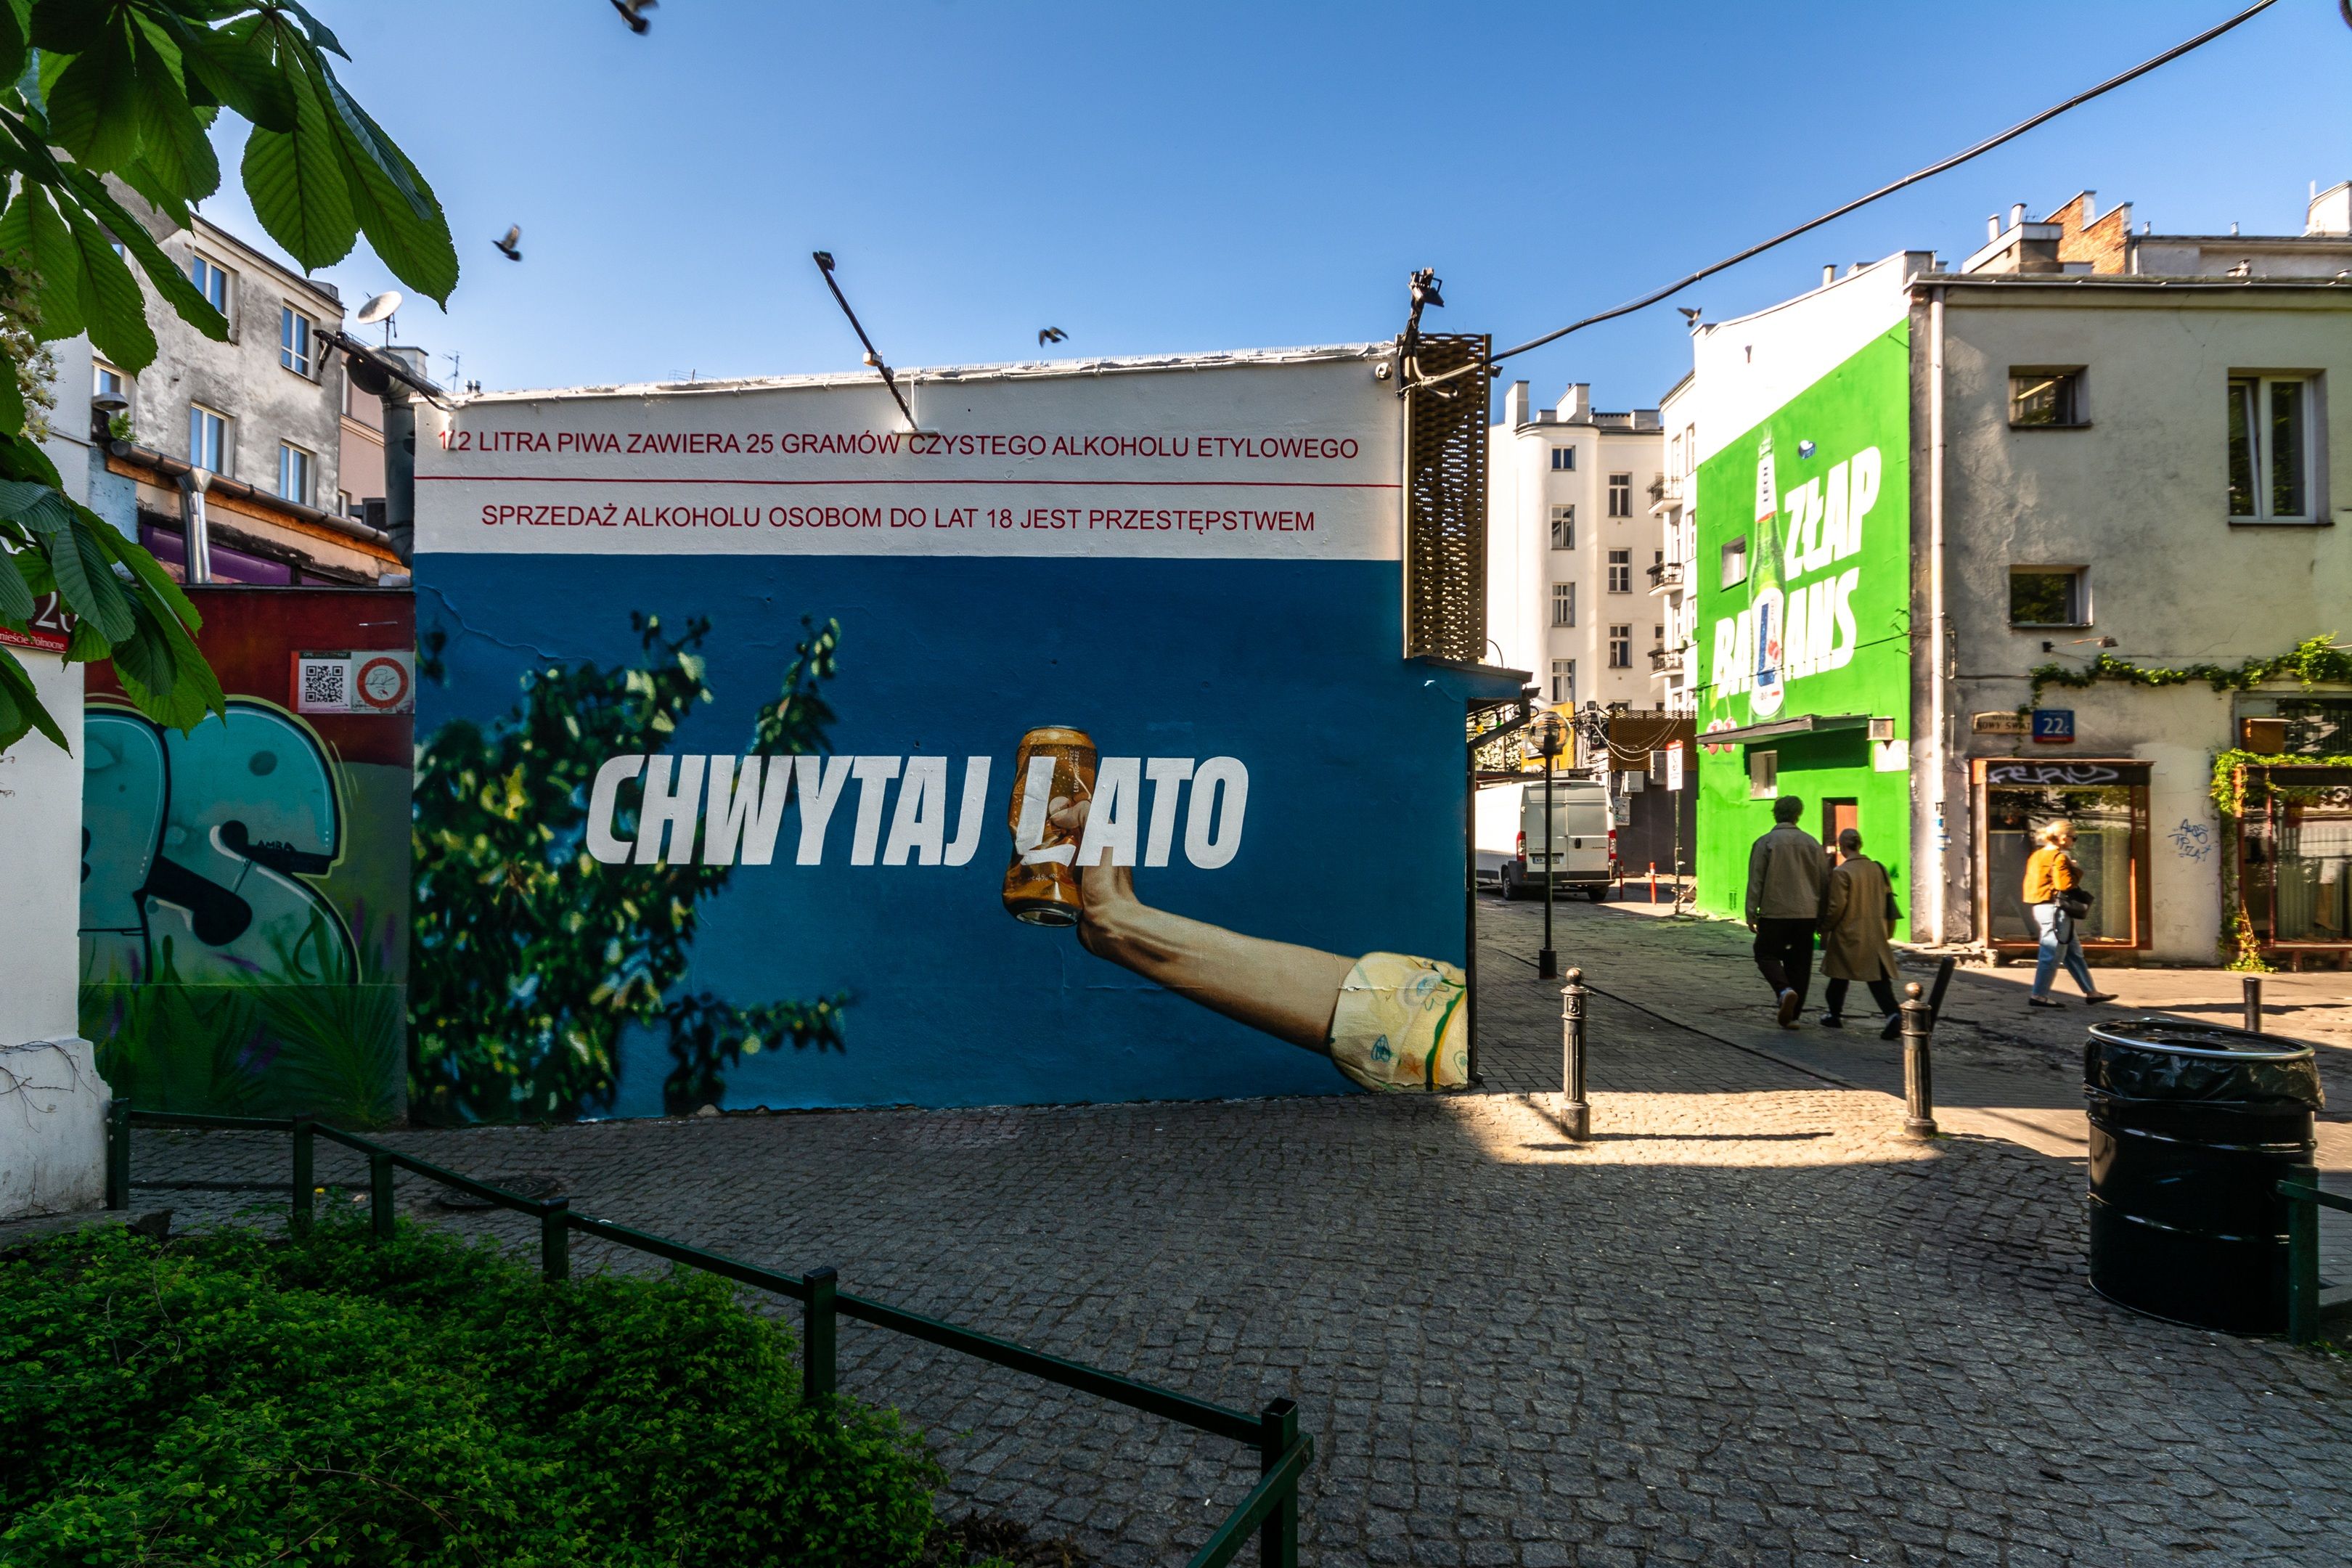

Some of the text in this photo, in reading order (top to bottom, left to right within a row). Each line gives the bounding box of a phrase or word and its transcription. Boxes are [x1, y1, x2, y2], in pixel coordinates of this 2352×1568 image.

[438, 430, 1359, 459] 1/2 LITRA PIWA ZAWIERA 25 GRAMÓW CZYSTEGO ALKOHOLU ETYLOWEGO
[482, 502, 1315, 534] SPRZEDAŻ ALKOHOLU OSOBOM DO LAT 18 JEST PRZESTĘPSTWEM
[1784, 446, 1881, 581] ZŁAP
[586, 754, 1249, 870] CHWYTAJ LATO
